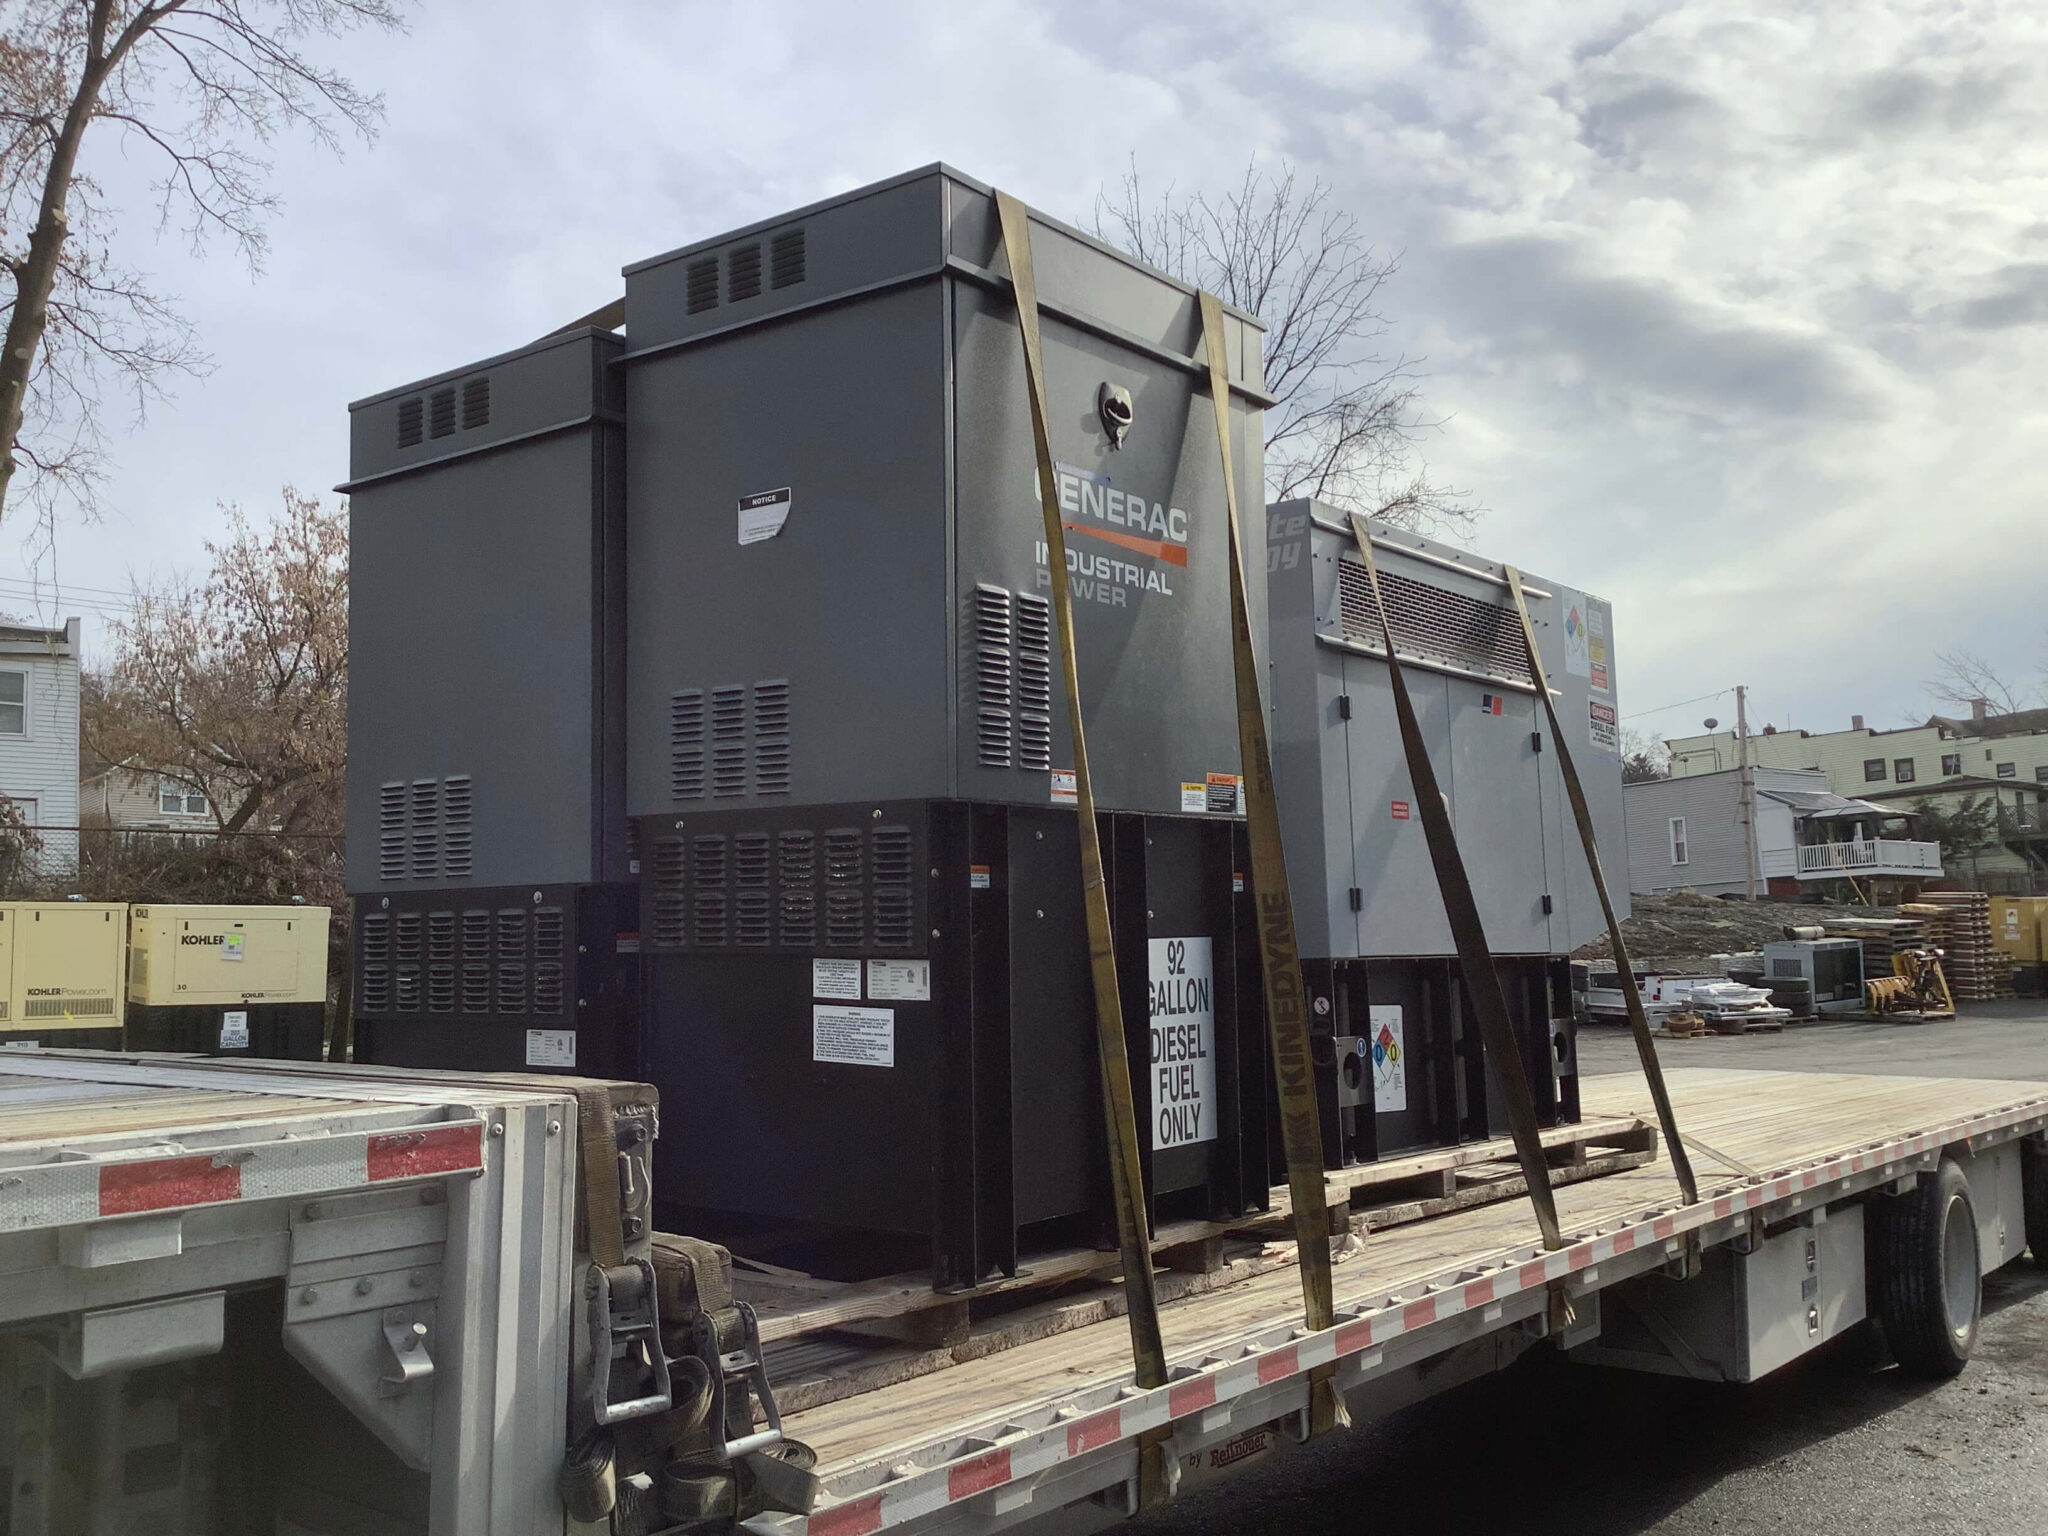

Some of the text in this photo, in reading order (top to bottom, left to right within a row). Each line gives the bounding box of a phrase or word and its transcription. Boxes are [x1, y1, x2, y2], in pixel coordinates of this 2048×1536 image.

[752, 494, 777, 506] NOTICE
[1036, 568, 1127, 607] PWER
[1590, 720, 1606, 733] DIESEL
[181, 935, 224, 945] KOHLER
[1167, 940, 1185, 975] 92
[1262, 893, 1308, 1097] KINEDYNE
[1150, 1023, 1207, 1064] DIESEL
[1159, 1063, 1200, 1104] FUEL
[1159, 1102, 1201, 1145] ONLY
[1189, 1452, 1202, 1469] by
